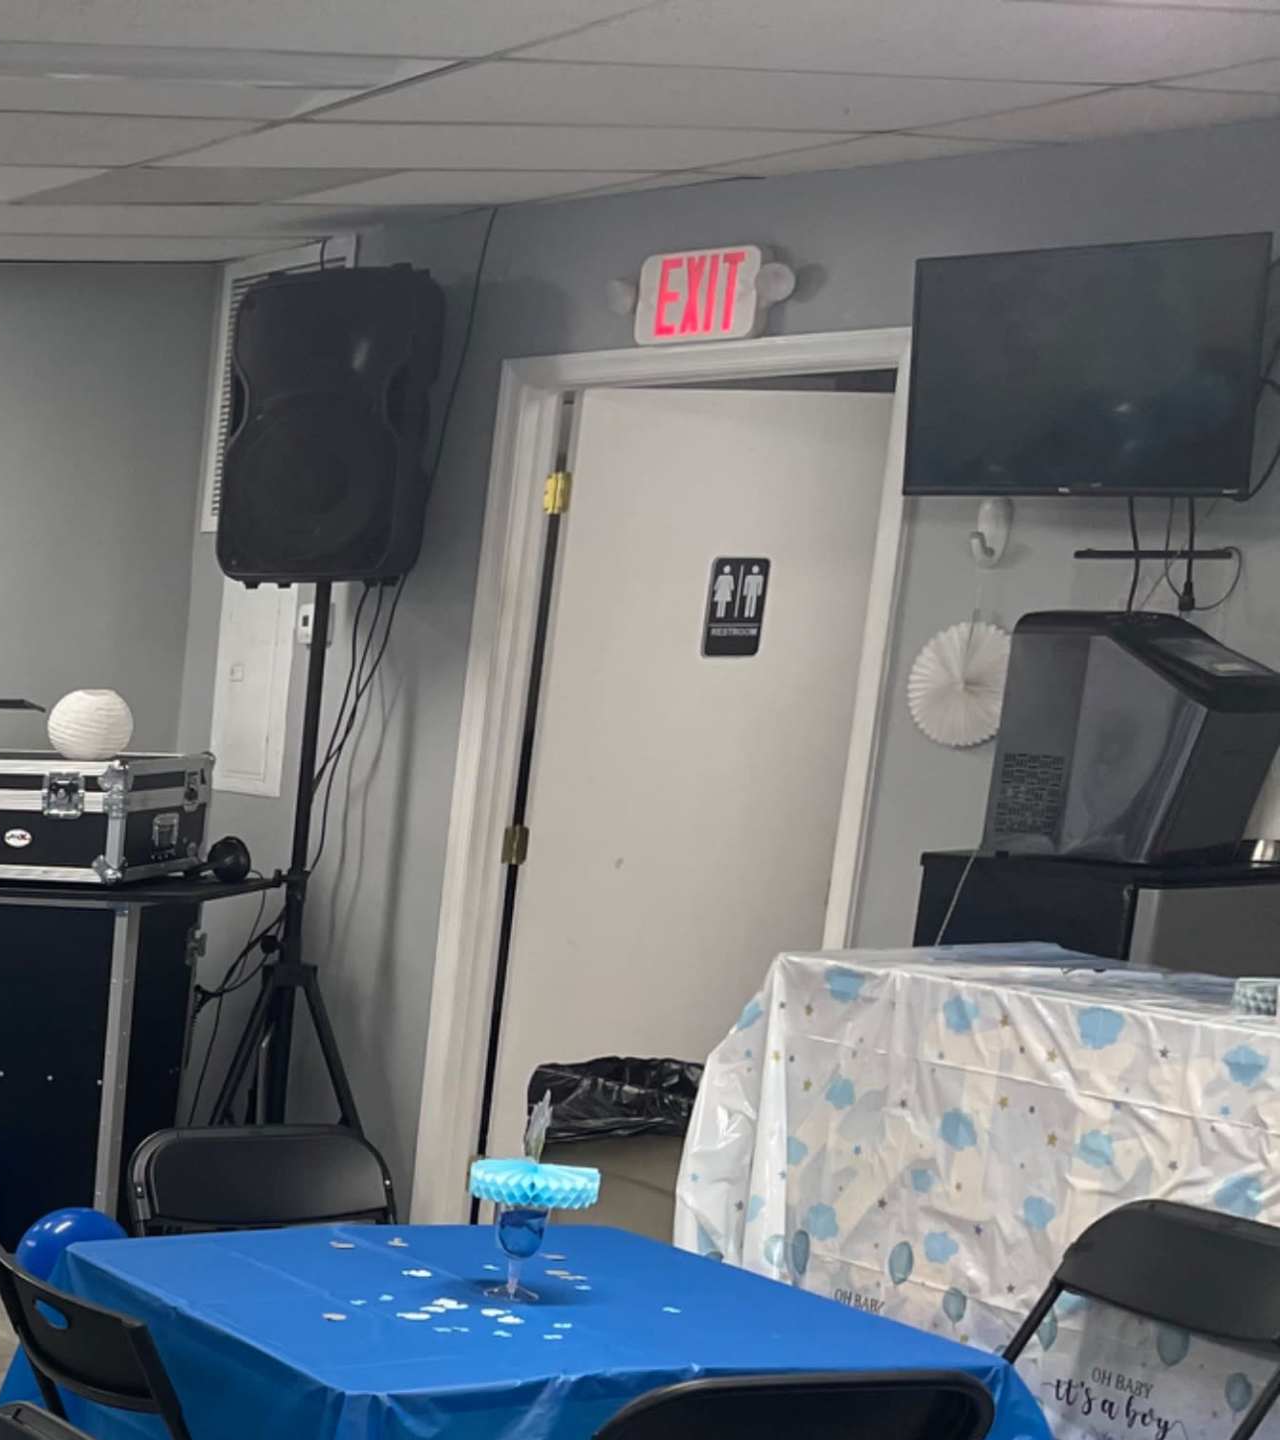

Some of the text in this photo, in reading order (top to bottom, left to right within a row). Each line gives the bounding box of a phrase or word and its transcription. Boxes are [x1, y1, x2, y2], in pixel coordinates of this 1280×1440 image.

[654, 251, 745, 336] EXIT
[1091, 1367, 1155, 1399] OH BABY
[1101, 1397, 1119, 1421] a
